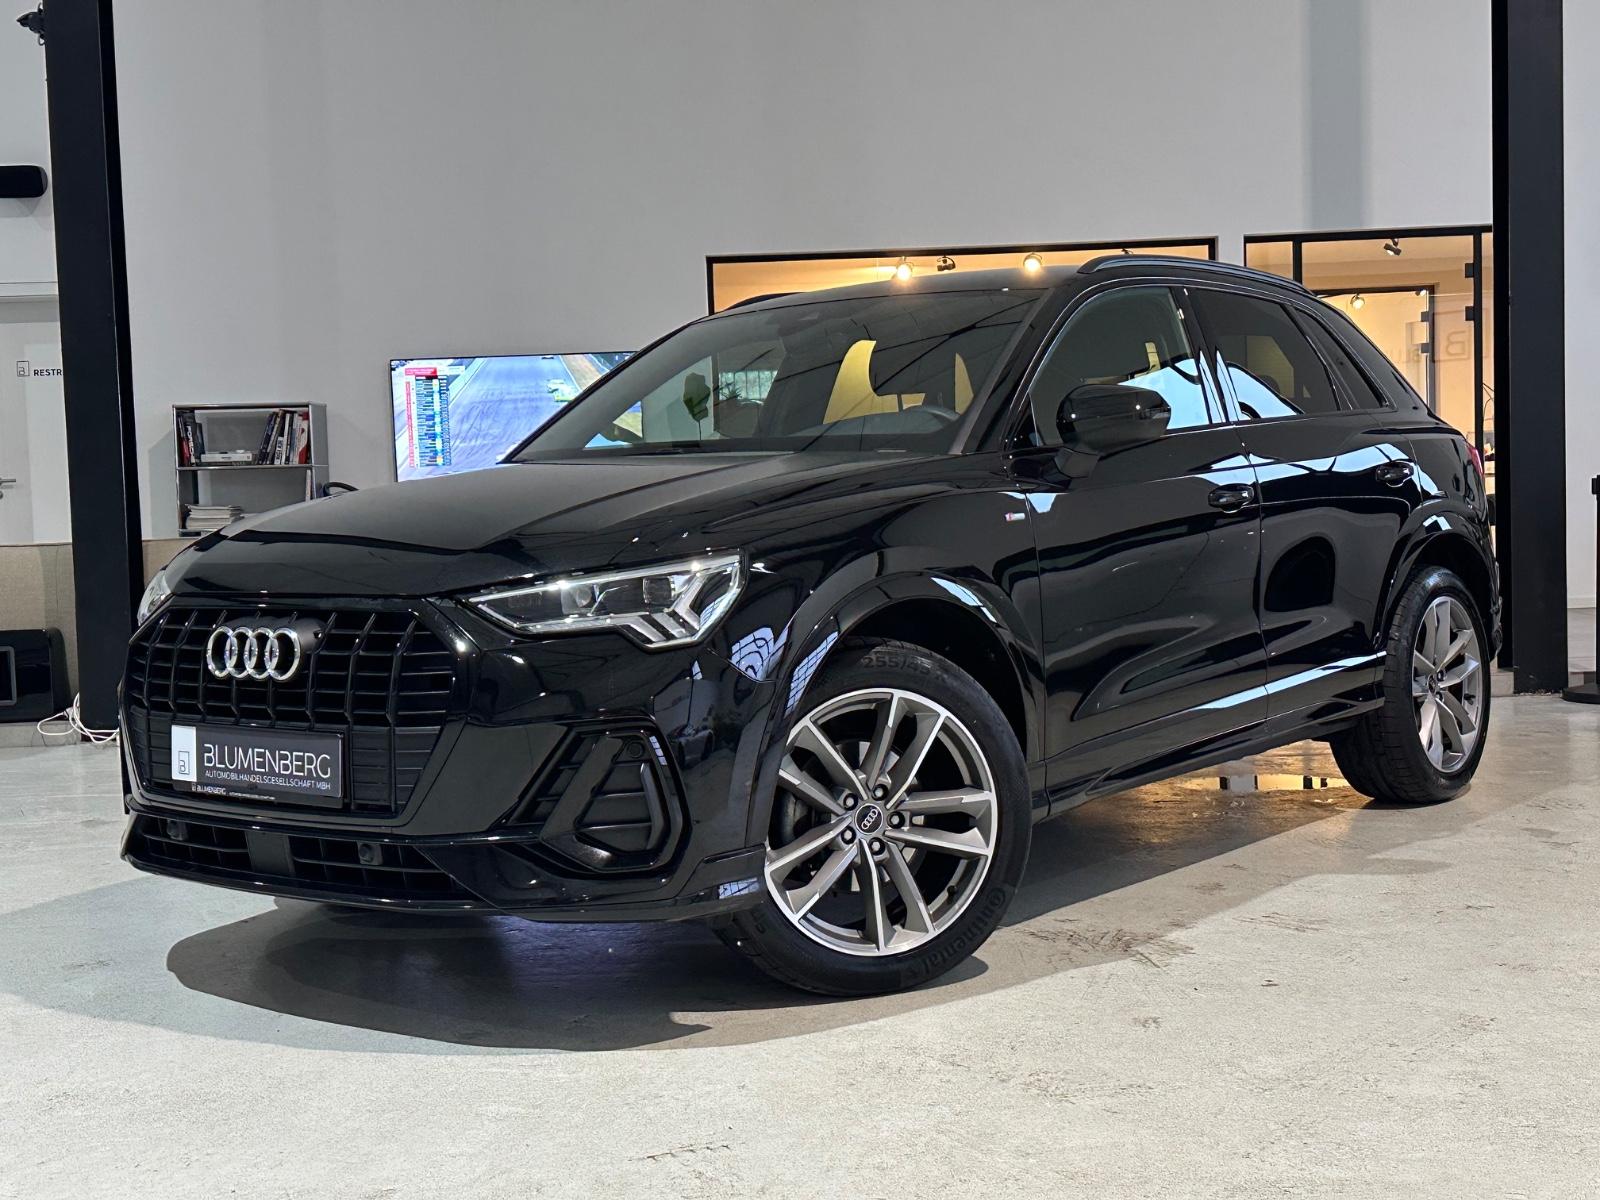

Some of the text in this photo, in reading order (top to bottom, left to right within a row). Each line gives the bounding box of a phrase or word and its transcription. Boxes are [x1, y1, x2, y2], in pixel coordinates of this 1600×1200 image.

[203, 743, 332, 779] BLUMENBERG
[205, 769, 316, 789] AUTOMOBILHANDELSGESELLSCHAFT
[316, 782, 331, 791] MBH
[922, 887, 1006, 975] Continental
